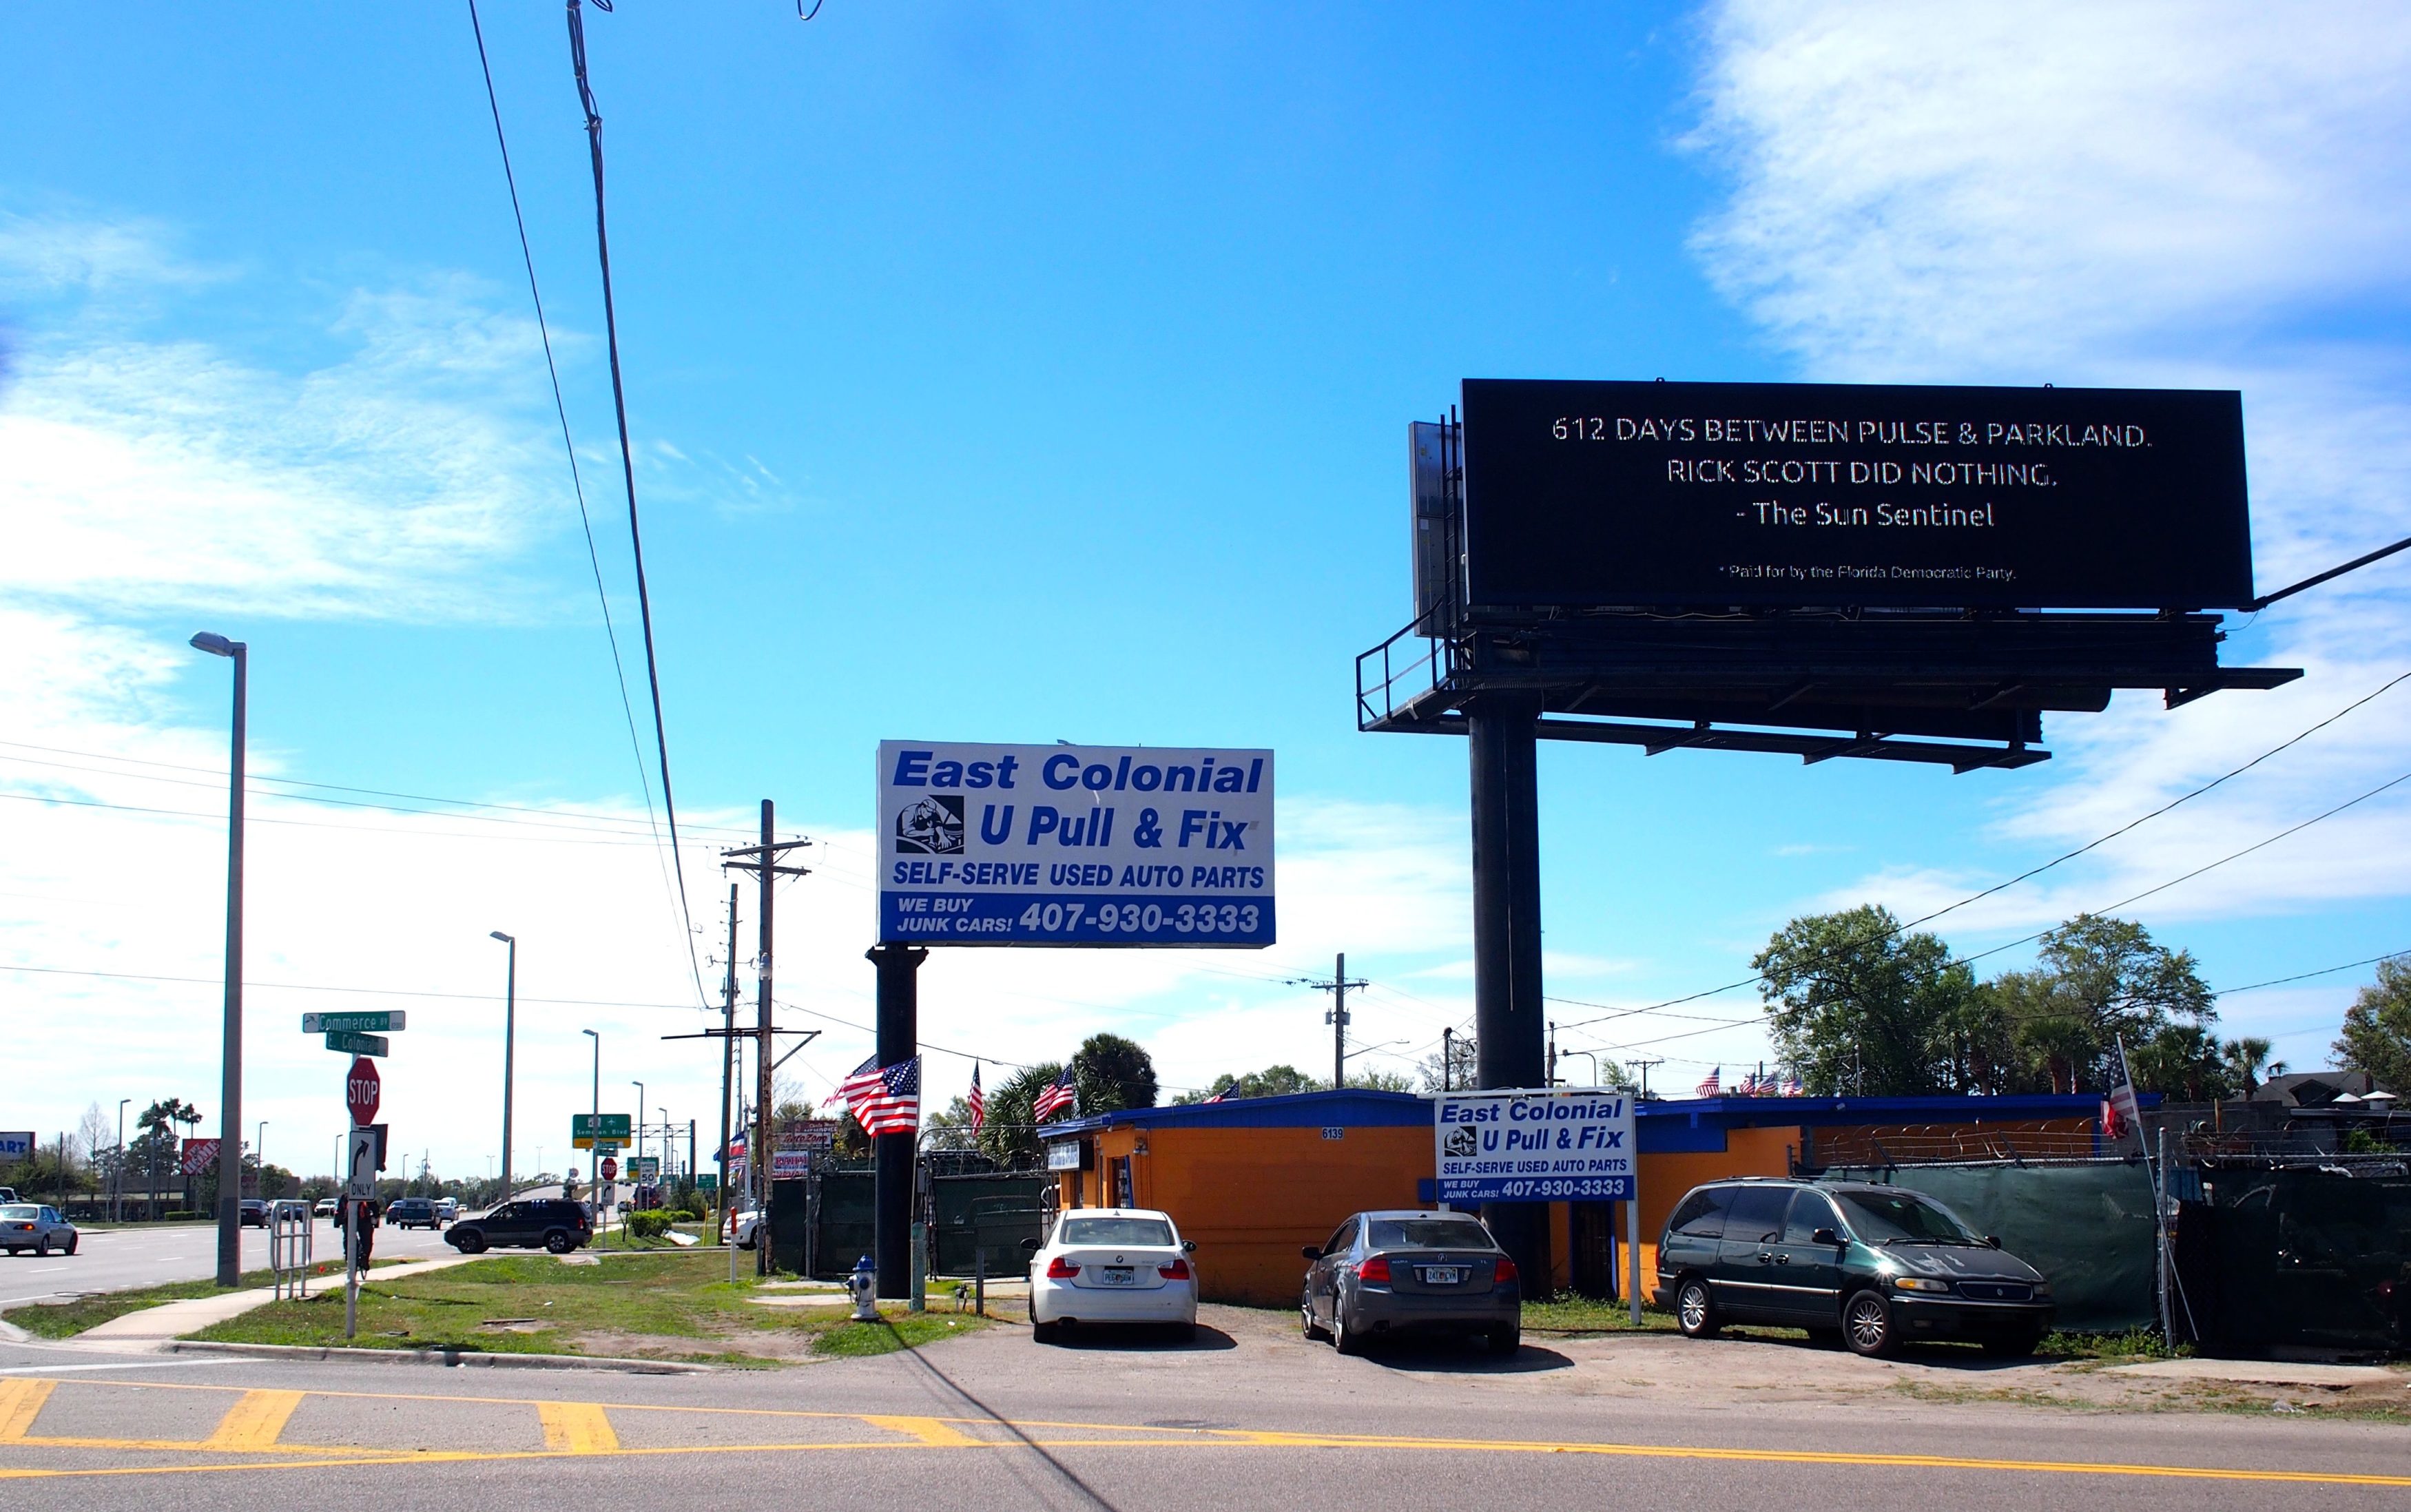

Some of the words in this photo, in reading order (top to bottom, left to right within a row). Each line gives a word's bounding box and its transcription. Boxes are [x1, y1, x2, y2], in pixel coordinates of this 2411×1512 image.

[1553, 417, 1604, 440] 612
[1616, 418, 1695, 441] DAYS
[1705, 419, 1848, 443] BETWEEN
[1859, 421, 1949, 444] PULSE
[1958, 422, 1978, 445] &
[1988, 423, 2152, 447] PARKLAND.
[1668, 459, 1735, 482] RICK
[1744, 459, 1841, 483] SCOTT
[1850, 462, 1901, 484] DID
[1912, 463, 2058, 486] NOTHING.
[1752, 501, 1807, 526] The
[1817, 502, 1867, 526] Sun
[1877, 502, 1994, 527] Sentinel
[1729, 565, 1762, 579] Paid
[1766, 565, 1784, 579] for
[1790, 565, 1807, 581] by
[1810, 566, 1833, 579] the
[1838, 565, 1886, 579] Florida
[1891, 566, 1972, 579] Democratic
[1976, 566, 2016, 581] Party.
[893, 750, 1019, 789] East
[1042, 754, 1263, 793] Colonial
[981, 805, 1014, 845] U
[1027, 806, 1115, 847] Pull
[1133, 807, 1163, 848] &
[1178, 810, 1248, 850] Fix
[893, 861, 1039, 885] SELF-SERVE
[1050, 863, 1113, 886] USED
[1119, 865, 1183, 887] AUTO
[1191, 866, 1264, 889] PARTS
[898, 898, 928, 912] WE
[933, 898, 974, 913] BUY
[897, 918, 951, 932] JUNK
[955, 918, 1013, 932] CARS!
[1020, 903, 1259, 933] 407-930-3333
[319, 1015, 376, 1031] Commerce
[328, 1033, 336, 1048] E.
[342, 1034, 376, 1053] Colonial
[349, 1079, 378, 1106] STOP
[1440, 1104, 1501, 1123] East
[1509, 1099, 1623, 1121] Colonial
[1323, 1128, 1343, 1139] 6139
[1482, 1130, 1499, 1151] U
[1506, 1128, 1549, 1151] Pull
[1556, 1127, 1571, 1149] &
[1577, 1126, 1625, 1149] Fix
[182, 1139, 220, 1174] HOME
[1443, 1161, 1513, 1174] SELF-SERVE
[1517, 1160, 1549, 1172] USED
[1552, 1159, 1585, 1172] AUTO
[1589, 1158, 1627, 1171] PARTS
[602, 1164, 617, 1174] STOP
[641, 1173, 654, 1181] 50
[351, 1183, 371, 1196] ONLY
[1443, 1181, 1459, 1189] WE
[1460, 1180, 1480, 1188] BUY
[1502, 1179, 1624, 1197] 407-930-3333
[1443, 1190, 1469, 1199] JUNK
[1471, 1190, 1499, 1199] CARS!
